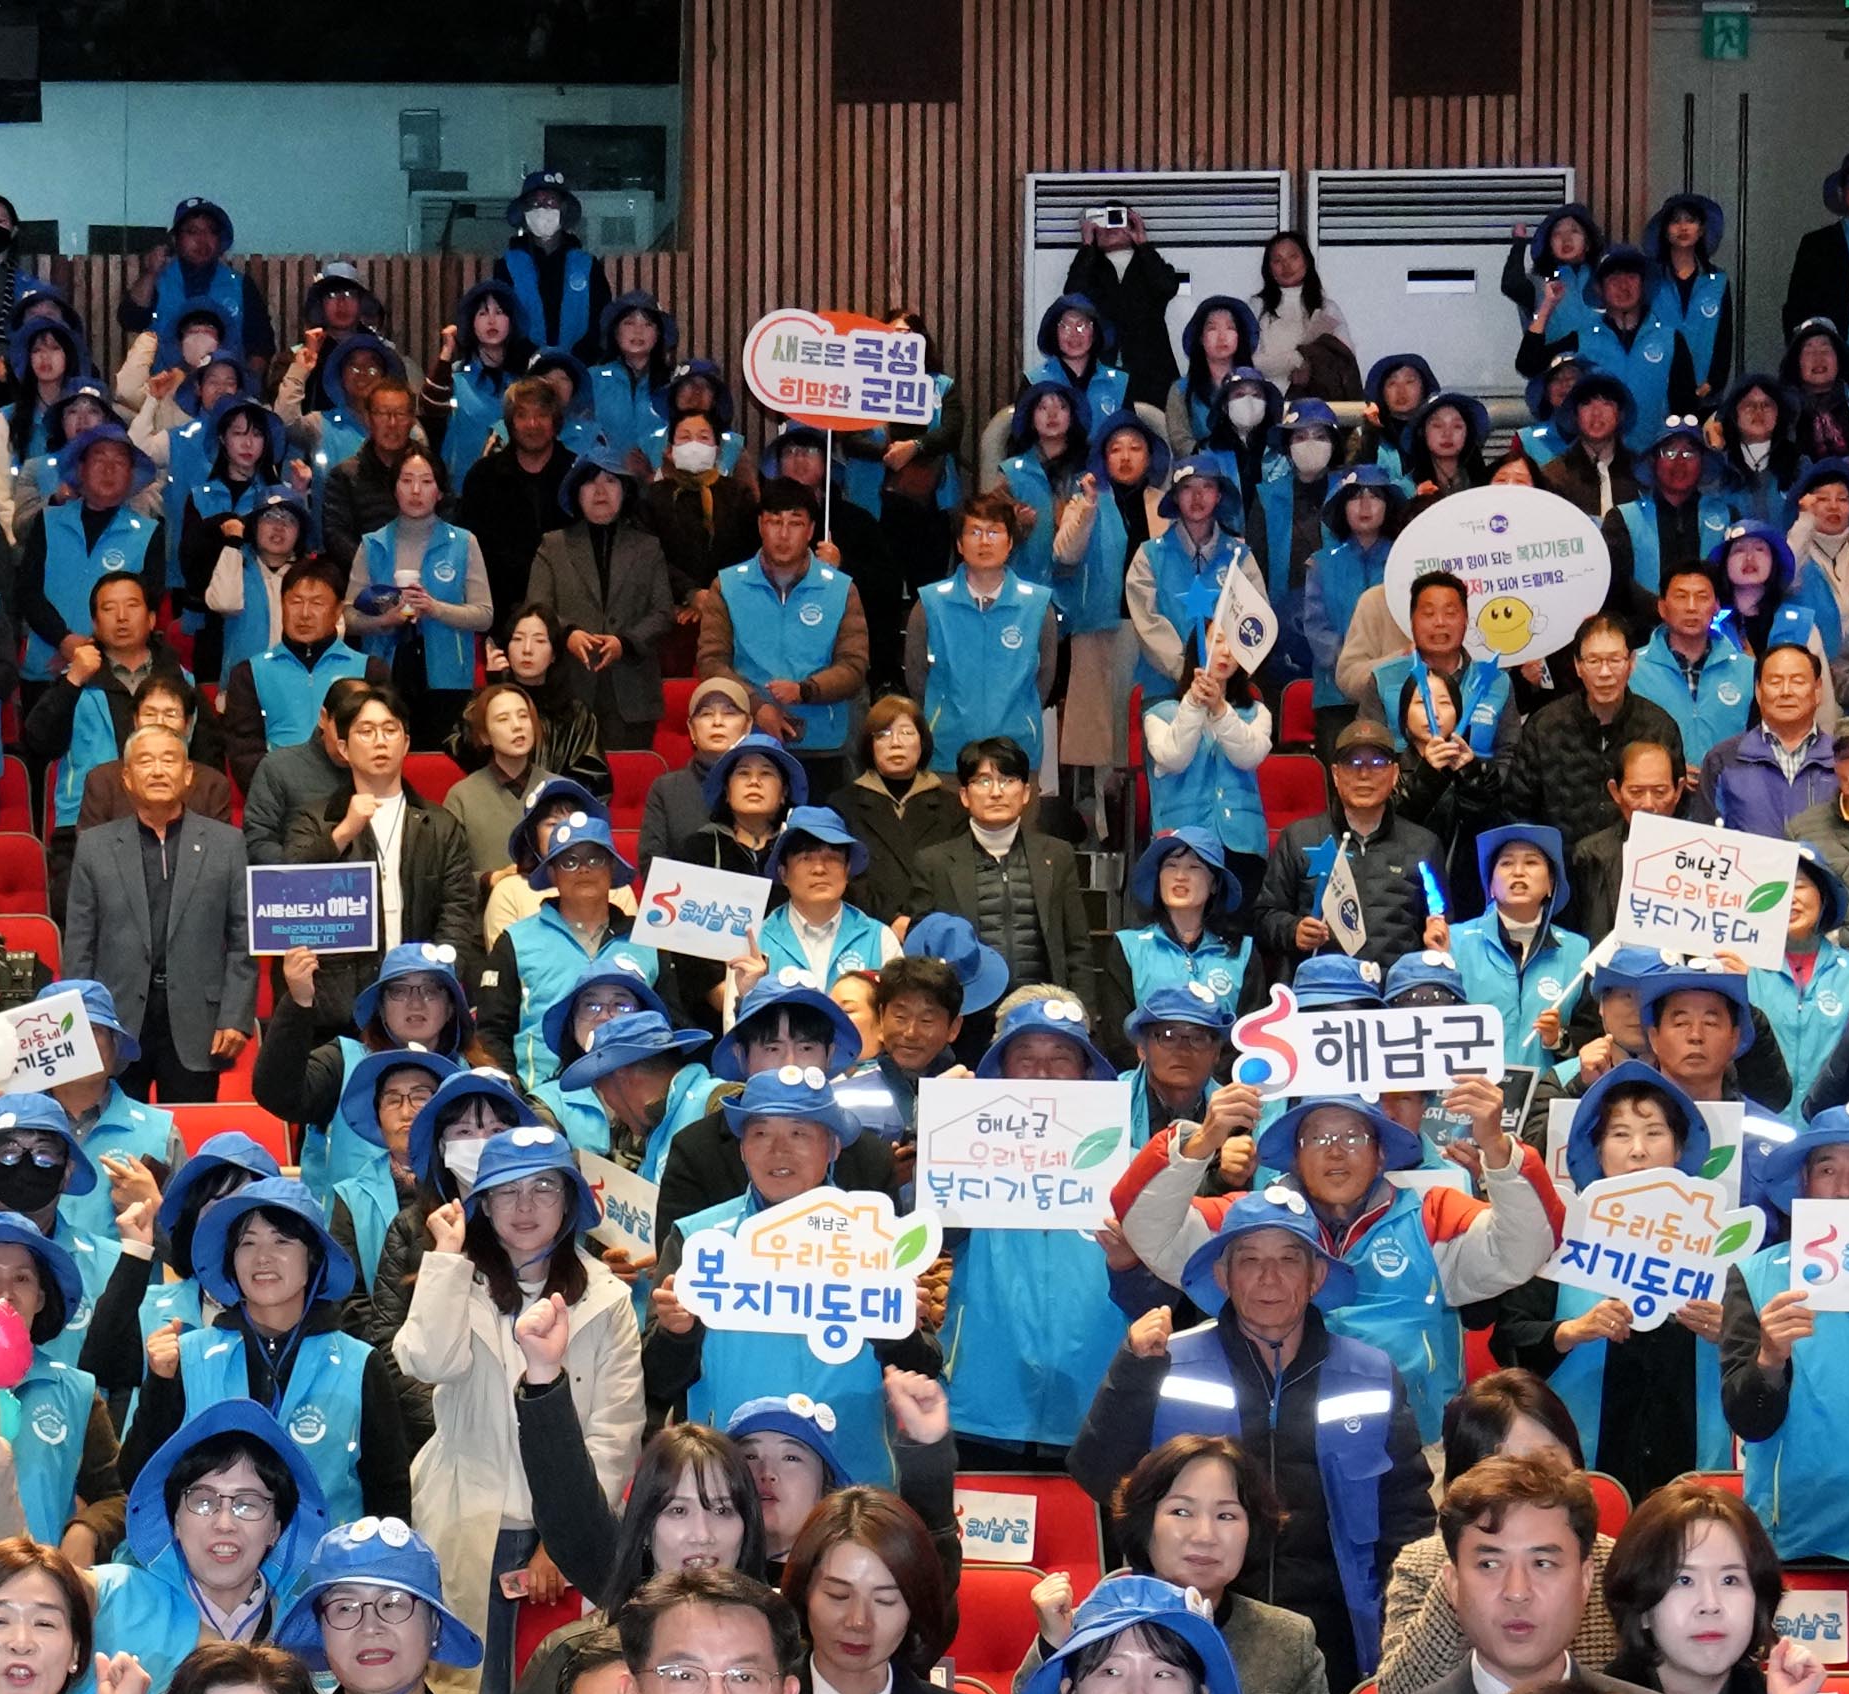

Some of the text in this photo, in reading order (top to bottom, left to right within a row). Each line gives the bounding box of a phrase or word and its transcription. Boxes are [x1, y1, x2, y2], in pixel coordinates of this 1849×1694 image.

[772, 334, 918, 376] 새로운 곡성
[860, 377, 927, 418] 군민
[1516, 537, 1585, 563] 복지기동대
[1675, 850, 1733, 881] 해남군
[327, 895, 369, 917] 해남
[1664, 874, 1742, 910] 우리동네
[678, 900, 753, 937] 해남군
[1630, 892, 1760, 944] 복지기동대
[20, 1027, 62, 1050] 리동네
[1312, 1015, 1496, 1083] 해남군
[12, 1040, 75, 1077] 기동대
[977, 1112, 1049, 1140] 해남군
[969, 1140, 1068, 1173] 우리동네
[927, 1169, 1094, 1211] 복지기동대
[605, 1194, 651, 1244] 해남군
[807, 1215, 849, 1232] 해남군
[1605, 1201, 1712, 1257] 우리동네
[765, 1233, 889, 1278] 우리동네
[689, 1248, 903, 1349] 복지기동대
[965, 1516, 1029, 1545] 해남군
[1771, 1612, 1843, 1641] 해남군
